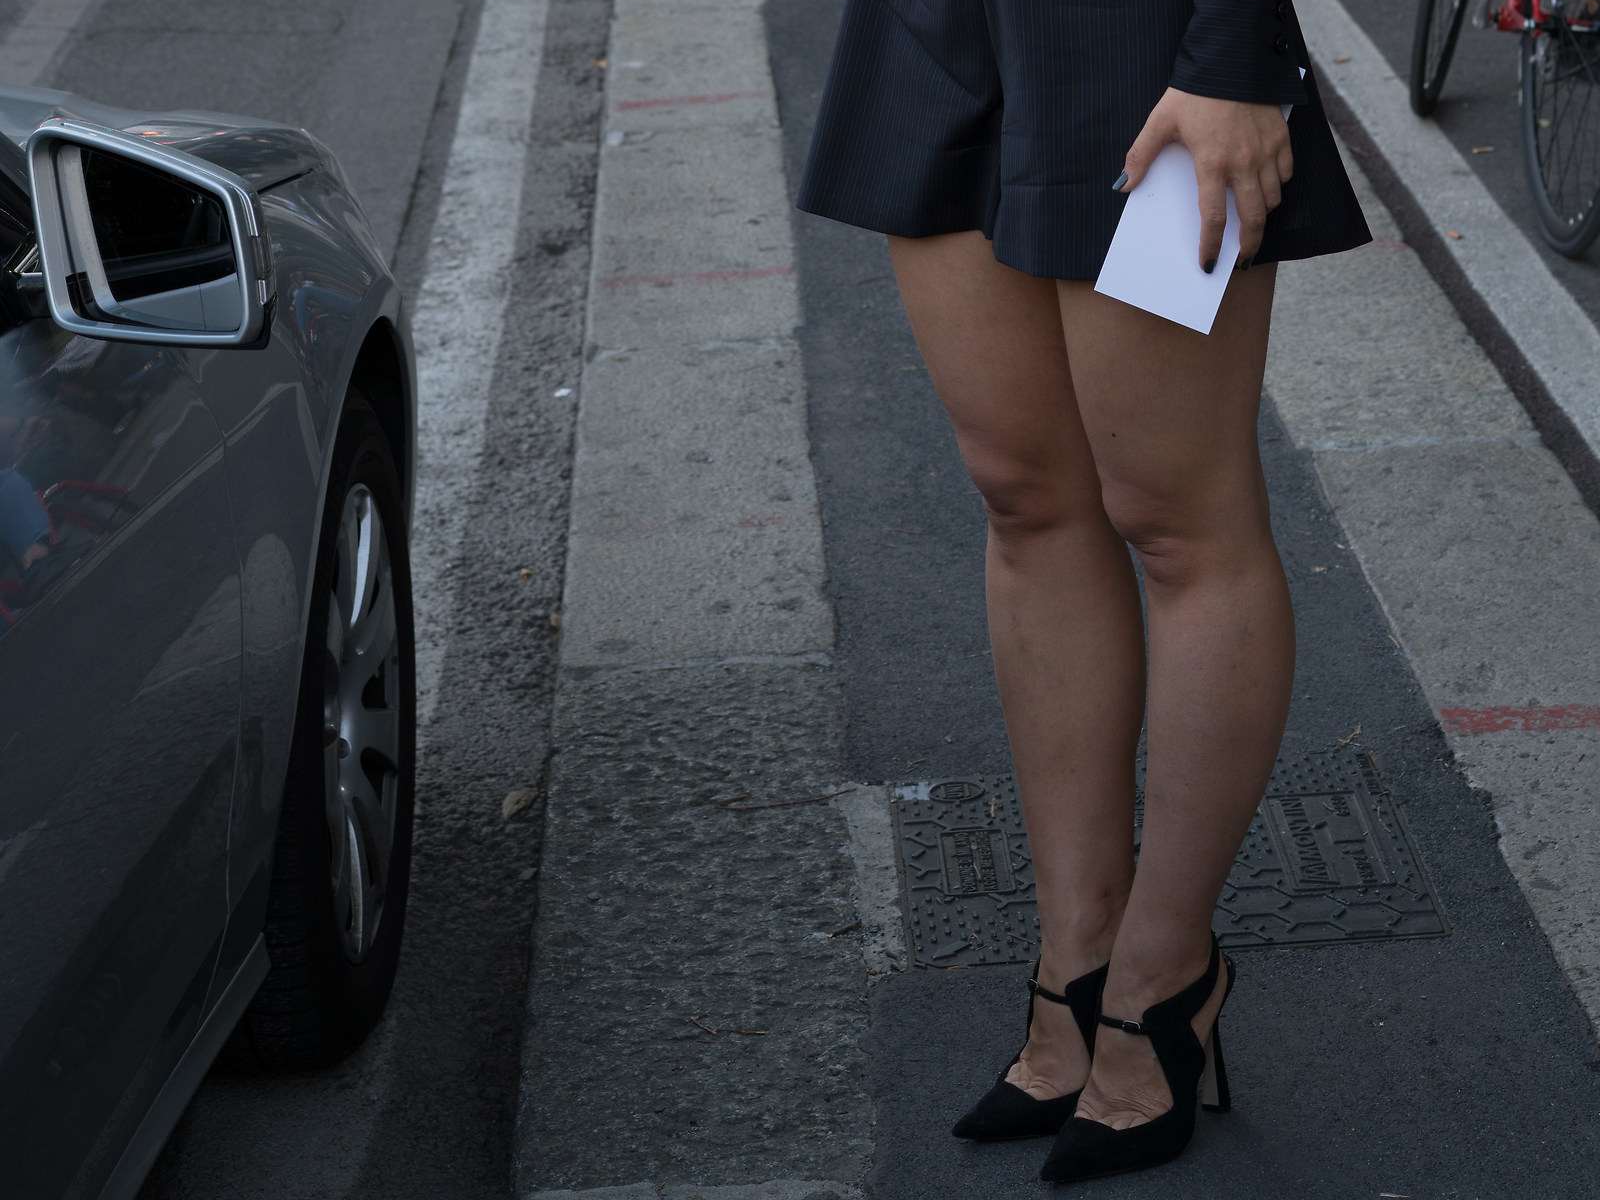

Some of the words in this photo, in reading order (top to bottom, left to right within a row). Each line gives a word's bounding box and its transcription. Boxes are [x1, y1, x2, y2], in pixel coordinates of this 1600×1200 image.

[1280, 796, 1322, 861] MONTINI
[954, 832, 971, 856] MILANO
[976, 831, 993, 868] METEORICHE
[957, 864, 976, 892] COMUNE
[982, 869, 997, 890] ACQUE
